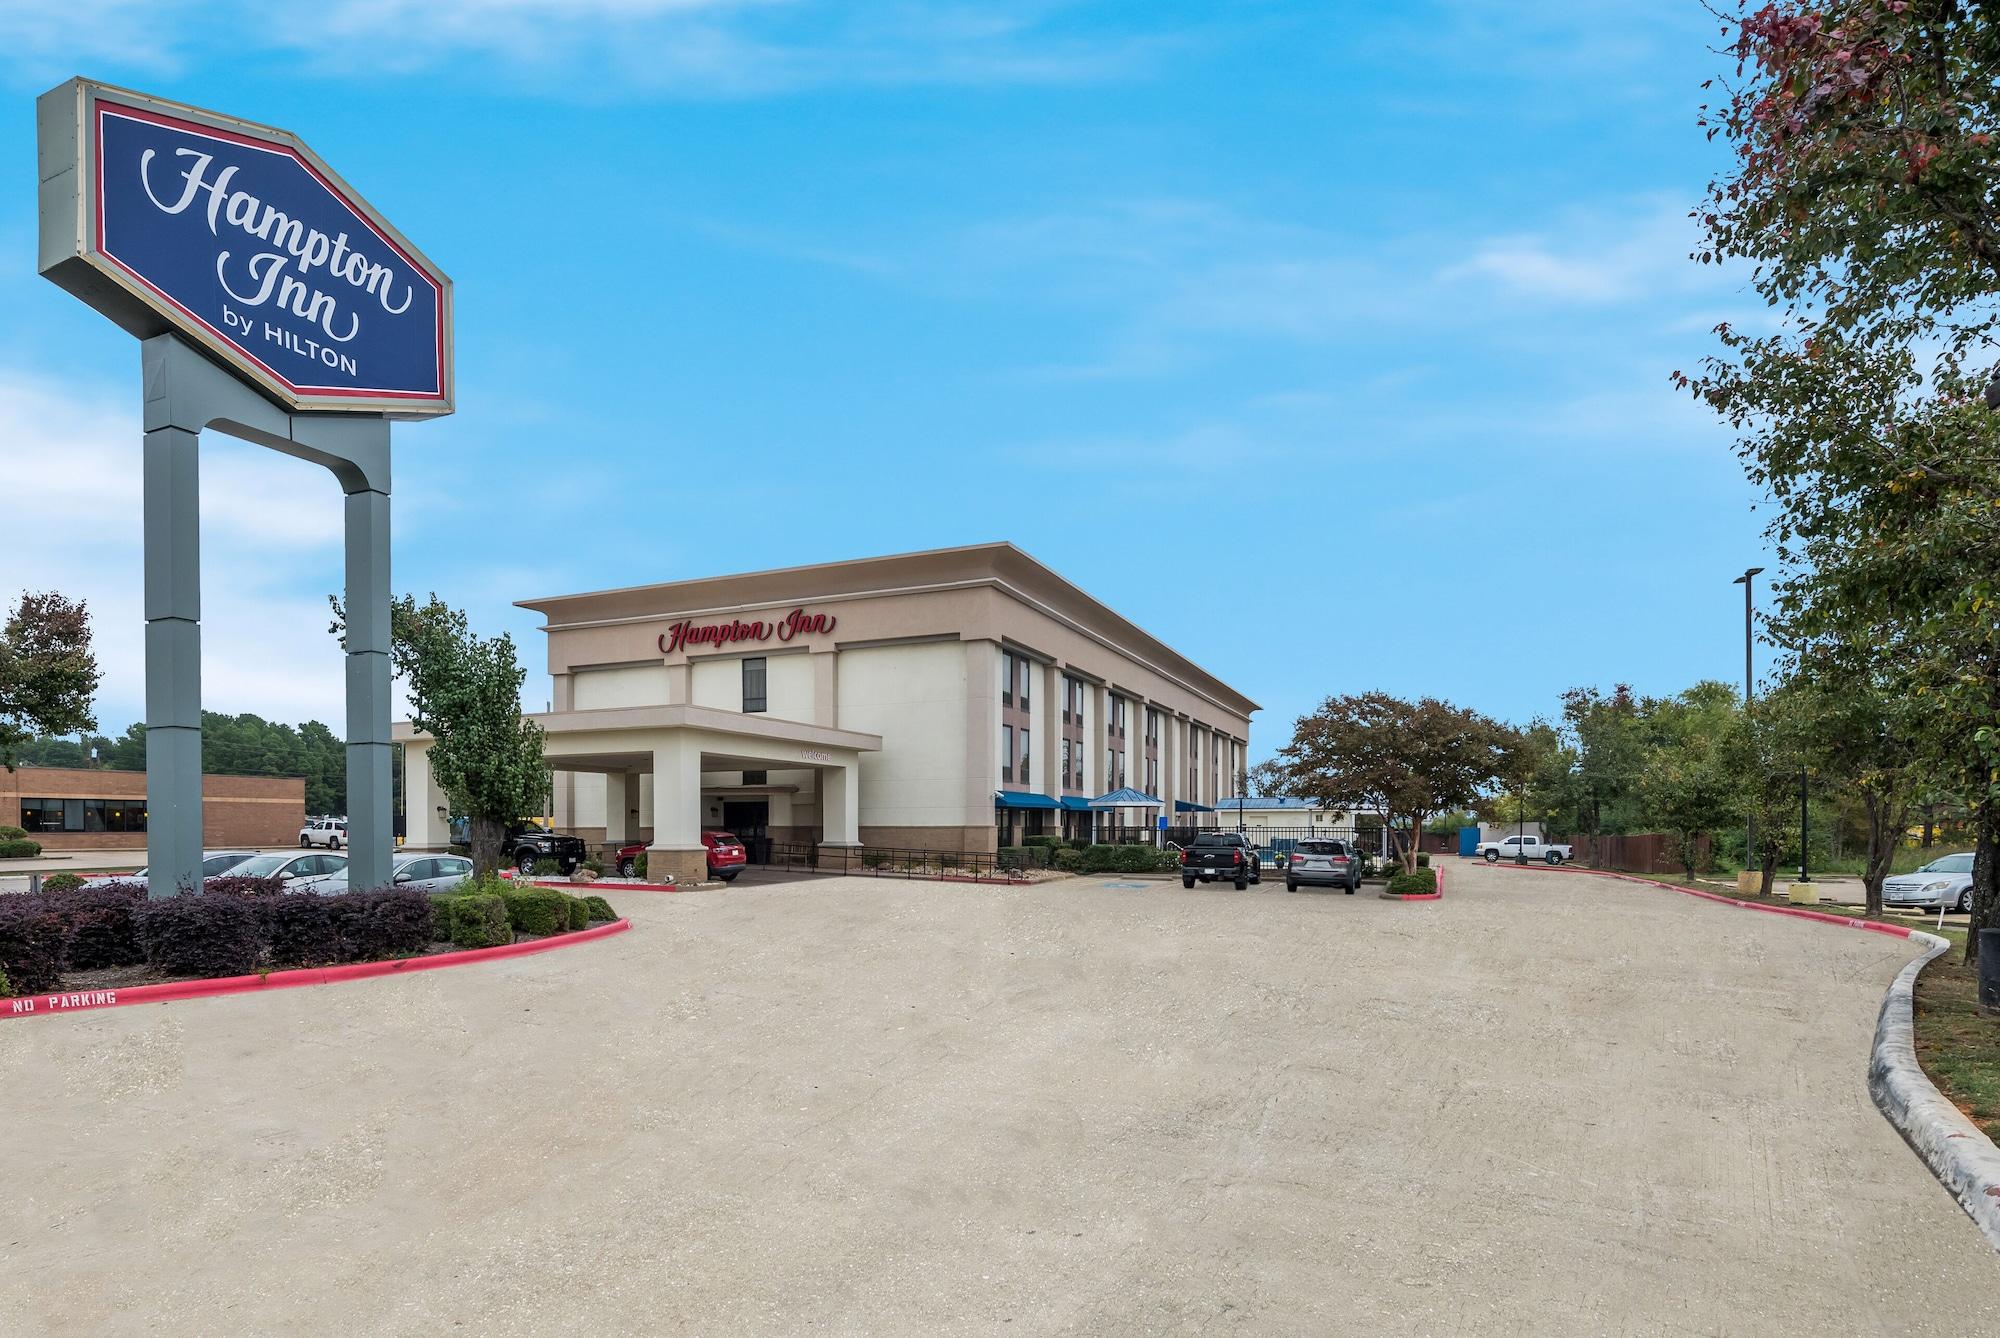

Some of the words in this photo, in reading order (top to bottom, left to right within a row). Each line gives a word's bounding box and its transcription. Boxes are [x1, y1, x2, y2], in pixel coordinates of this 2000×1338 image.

[139, 147, 412, 314] Hampton
[216, 250, 359, 342] Inn
[223, 304, 253, 337] by
[264, 321, 357, 377] HILTON
[658, 620, 773, 653] Hampton
[777, 608, 836, 642] Inn
[12, 1000, 35, 1013] NO
[48, 991, 116, 1009] PARKING
